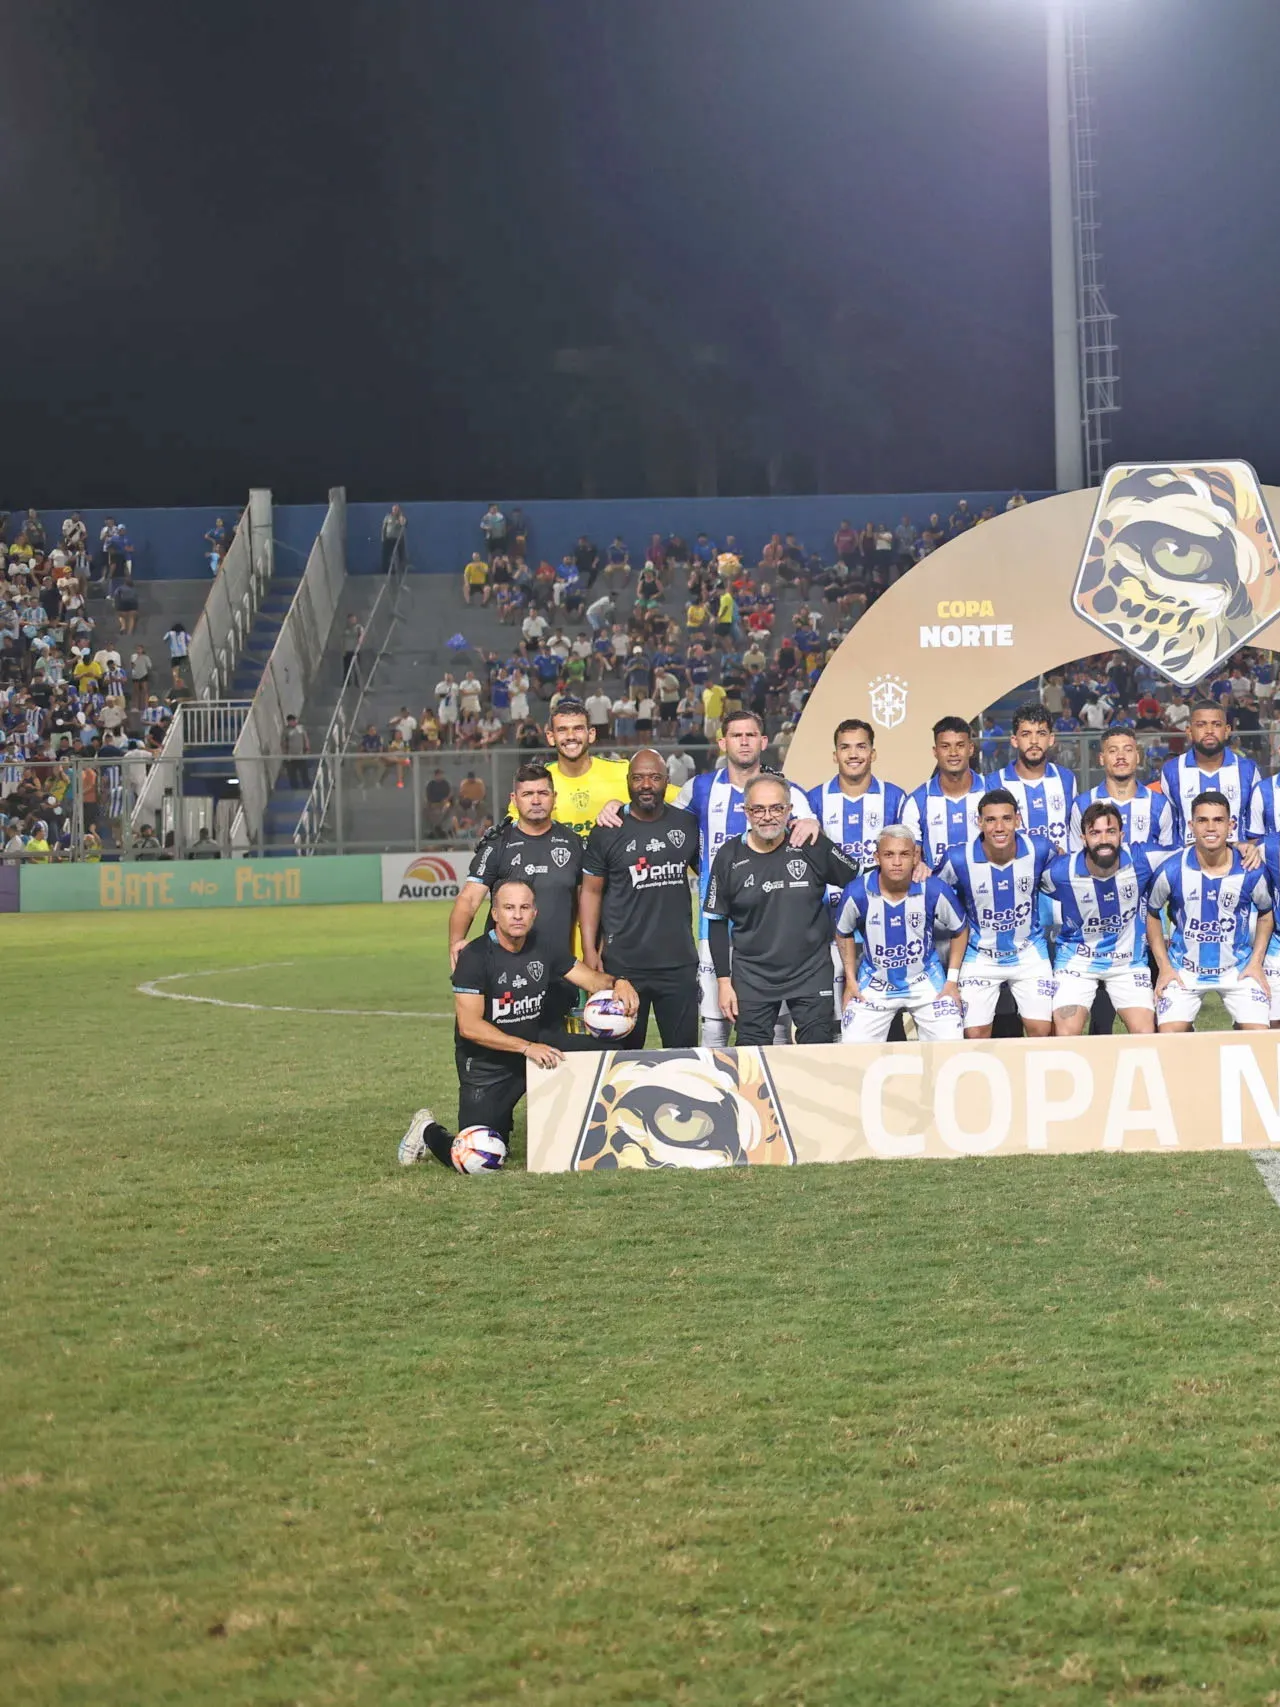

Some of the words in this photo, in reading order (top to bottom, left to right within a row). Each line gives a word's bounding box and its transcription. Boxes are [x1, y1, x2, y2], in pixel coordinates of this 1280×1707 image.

[937, 600, 994, 618] COPA
[920, 624, 1013, 648] NORTE
[398, 884, 459, 898] Aurora
[983, 908, 1014, 921] Bet
[1088, 915, 1121, 927] Bet
[992, 918, 1026, 931] Sorte
[1190, 918, 1219, 932] Bet
[875, 944, 904, 957] Bet
[882, 957, 918, 968] Sorte
[861, 1047, 1180, 1155] COPA
